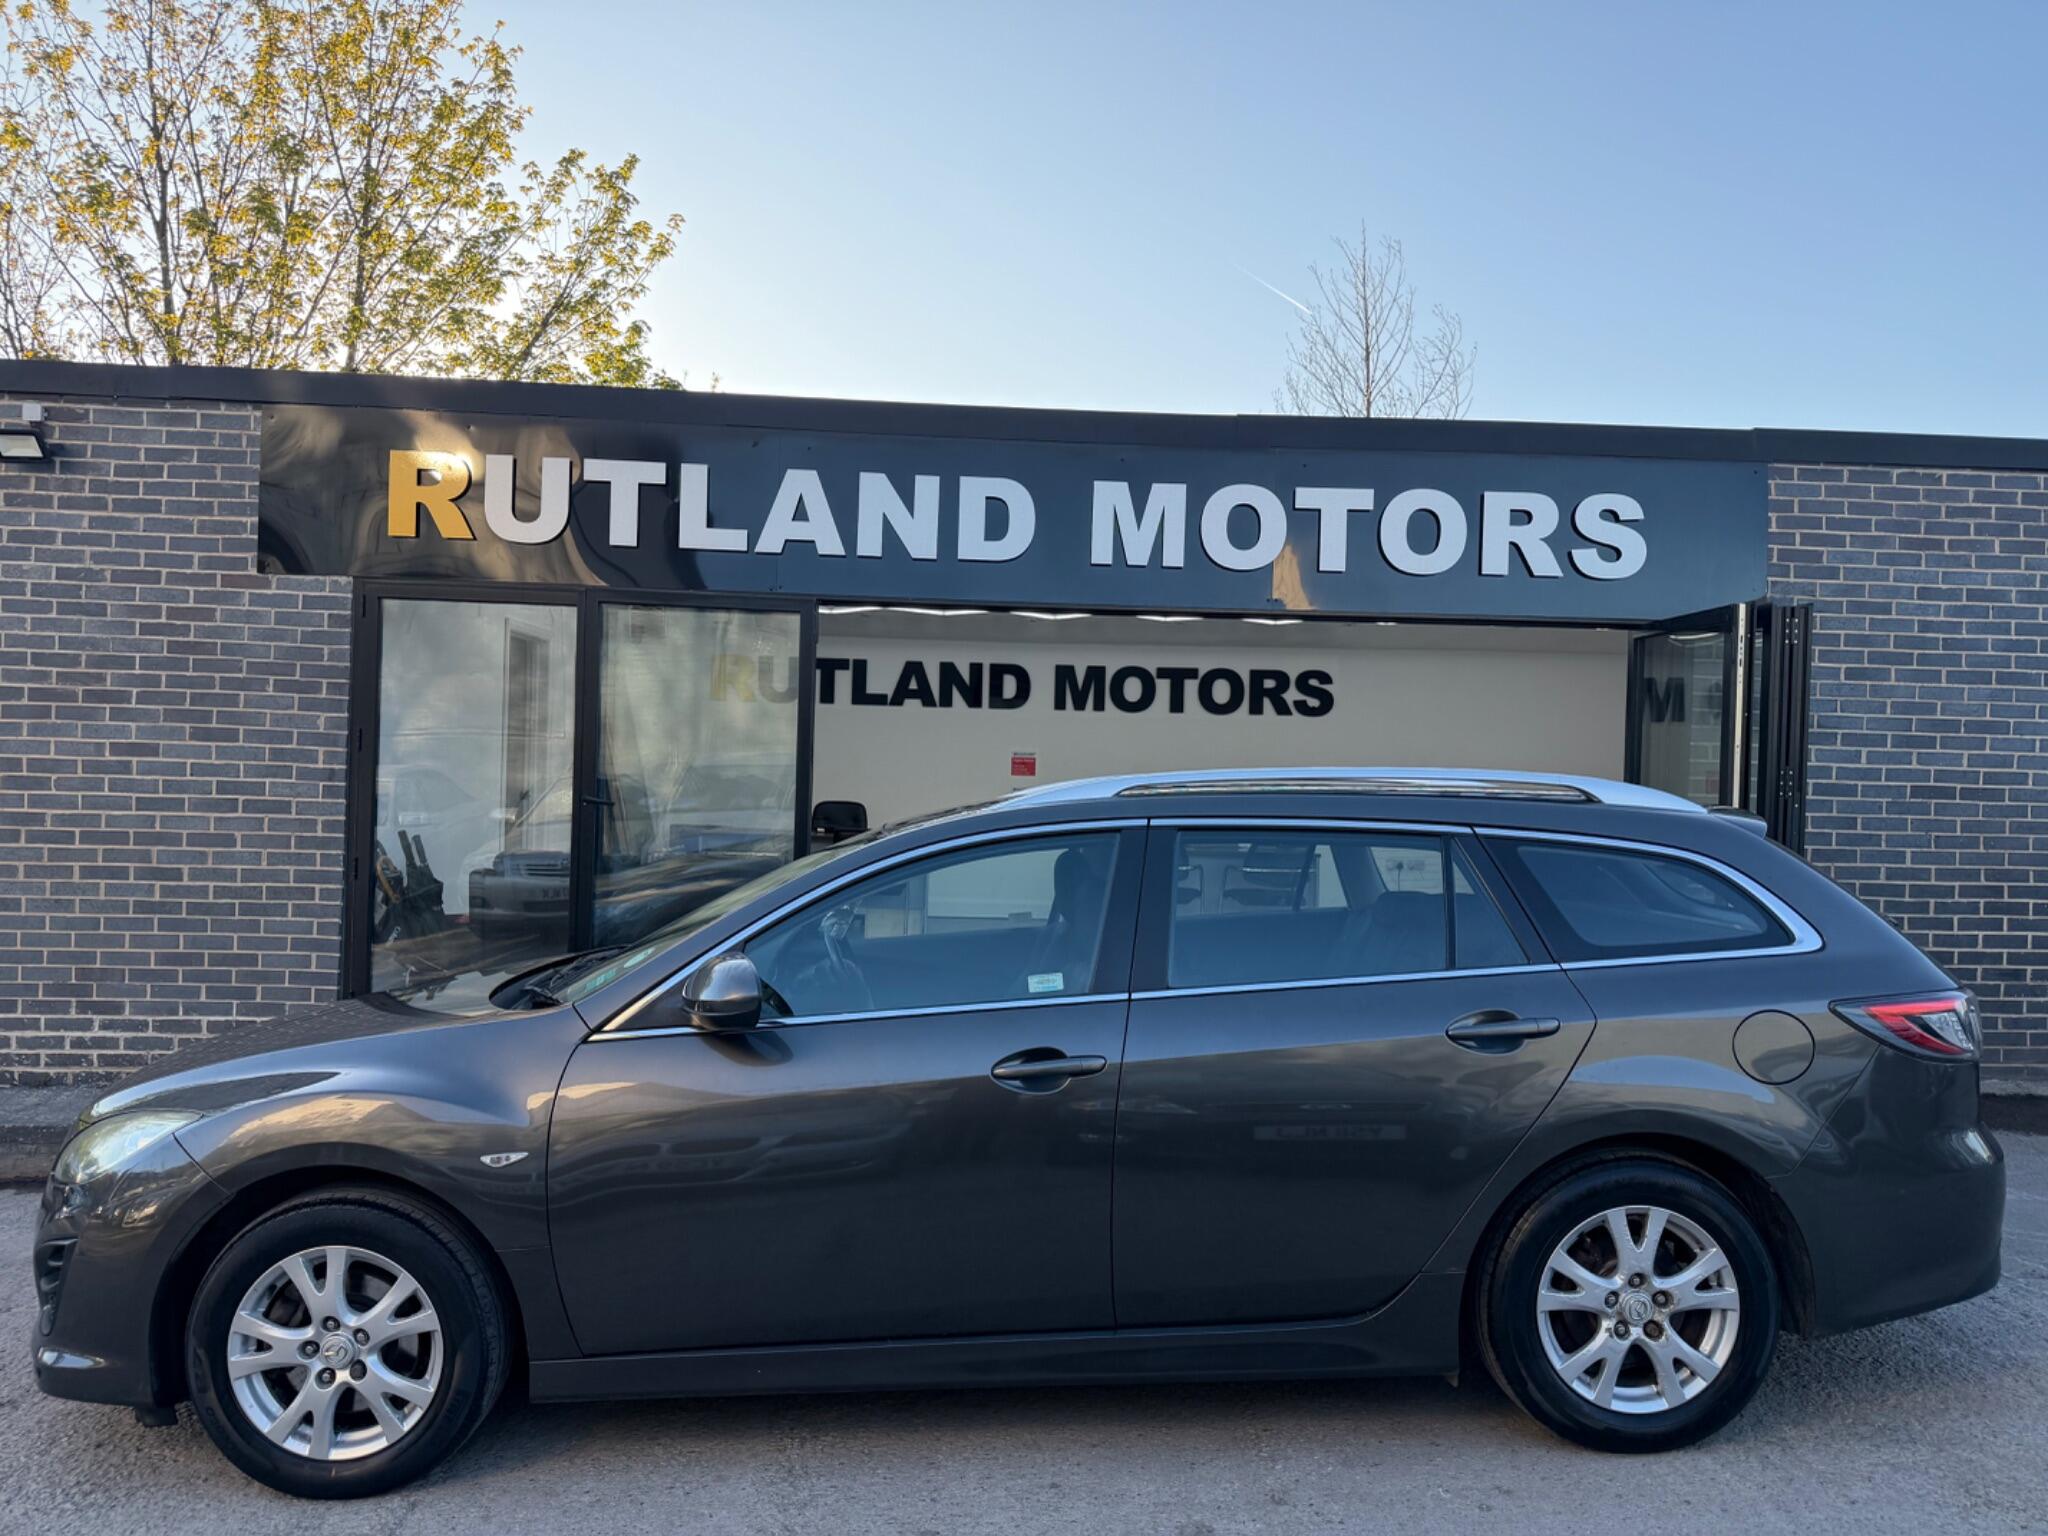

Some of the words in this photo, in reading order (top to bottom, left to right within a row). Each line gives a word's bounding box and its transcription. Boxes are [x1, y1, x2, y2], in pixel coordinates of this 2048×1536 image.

[386, 449, 1036, 562] RUTLAND
[1090, 480, 1648, 580] MOTORS
[1053, 664, 1335, 717] MOTORS
